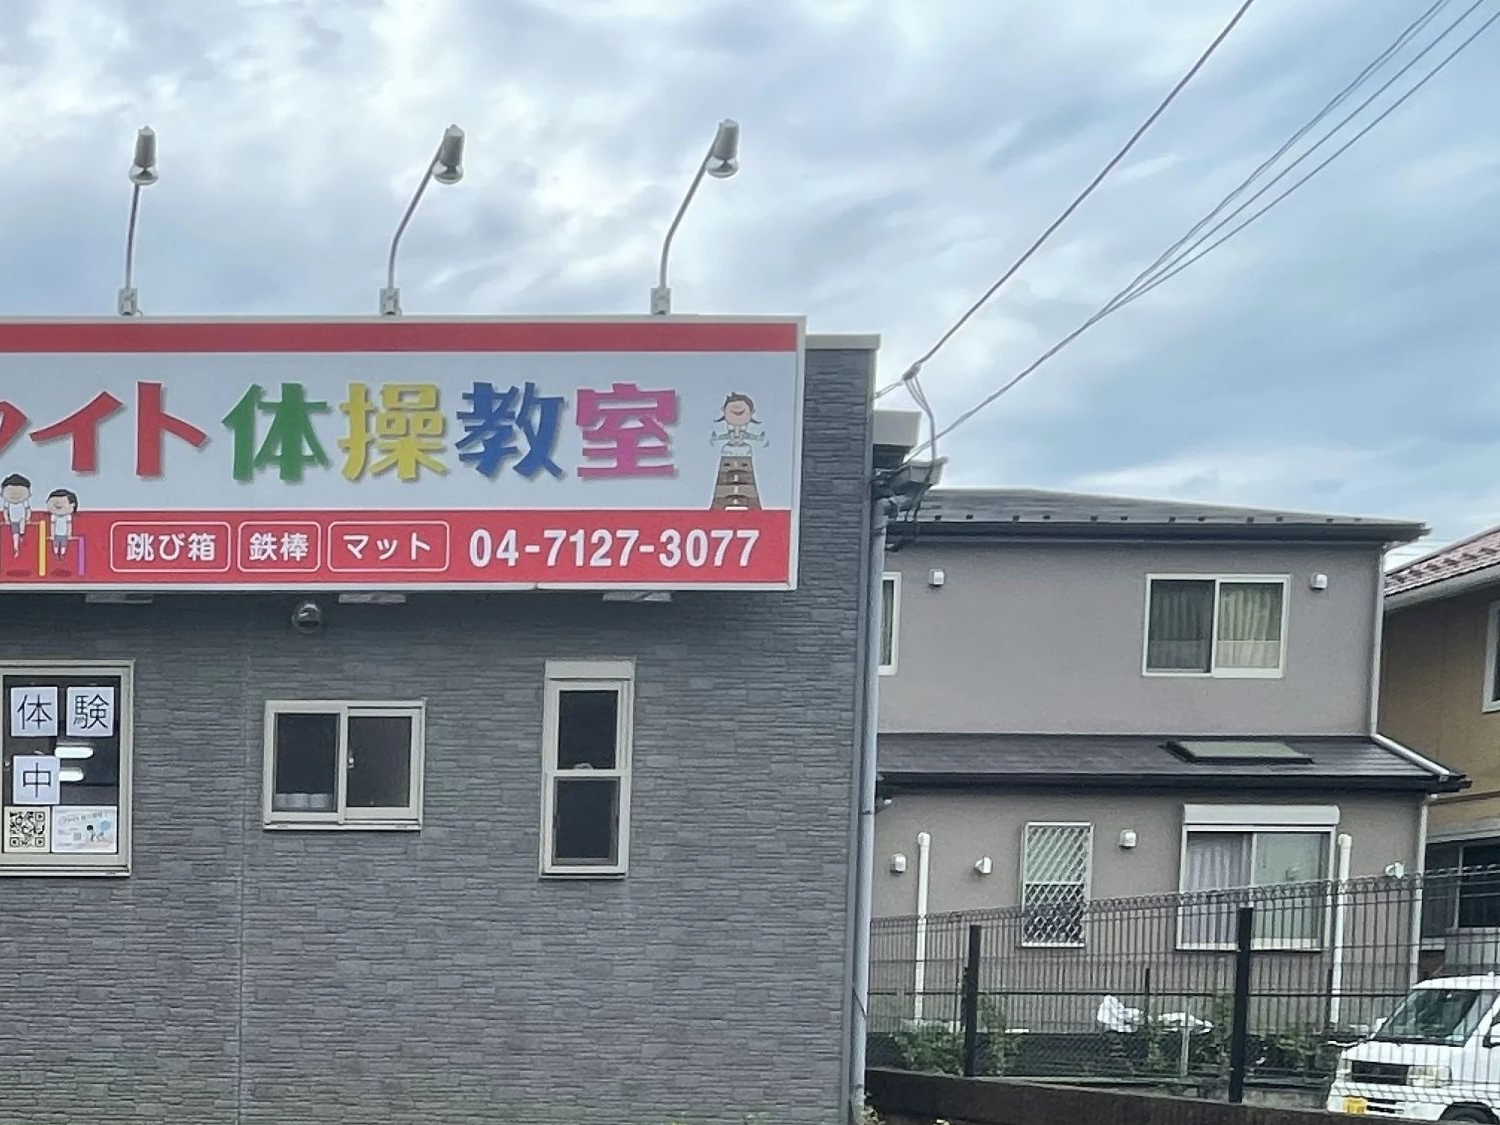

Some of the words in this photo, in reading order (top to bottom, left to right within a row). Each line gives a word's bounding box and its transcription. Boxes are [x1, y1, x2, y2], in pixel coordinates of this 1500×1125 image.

[126, 533, 216, 562] 跳び箱
[248, 531, 310, 561] 鉄棒
[342, 532, 432, 560] マット
[468, 527, 761, 568] 04-7127-3077
